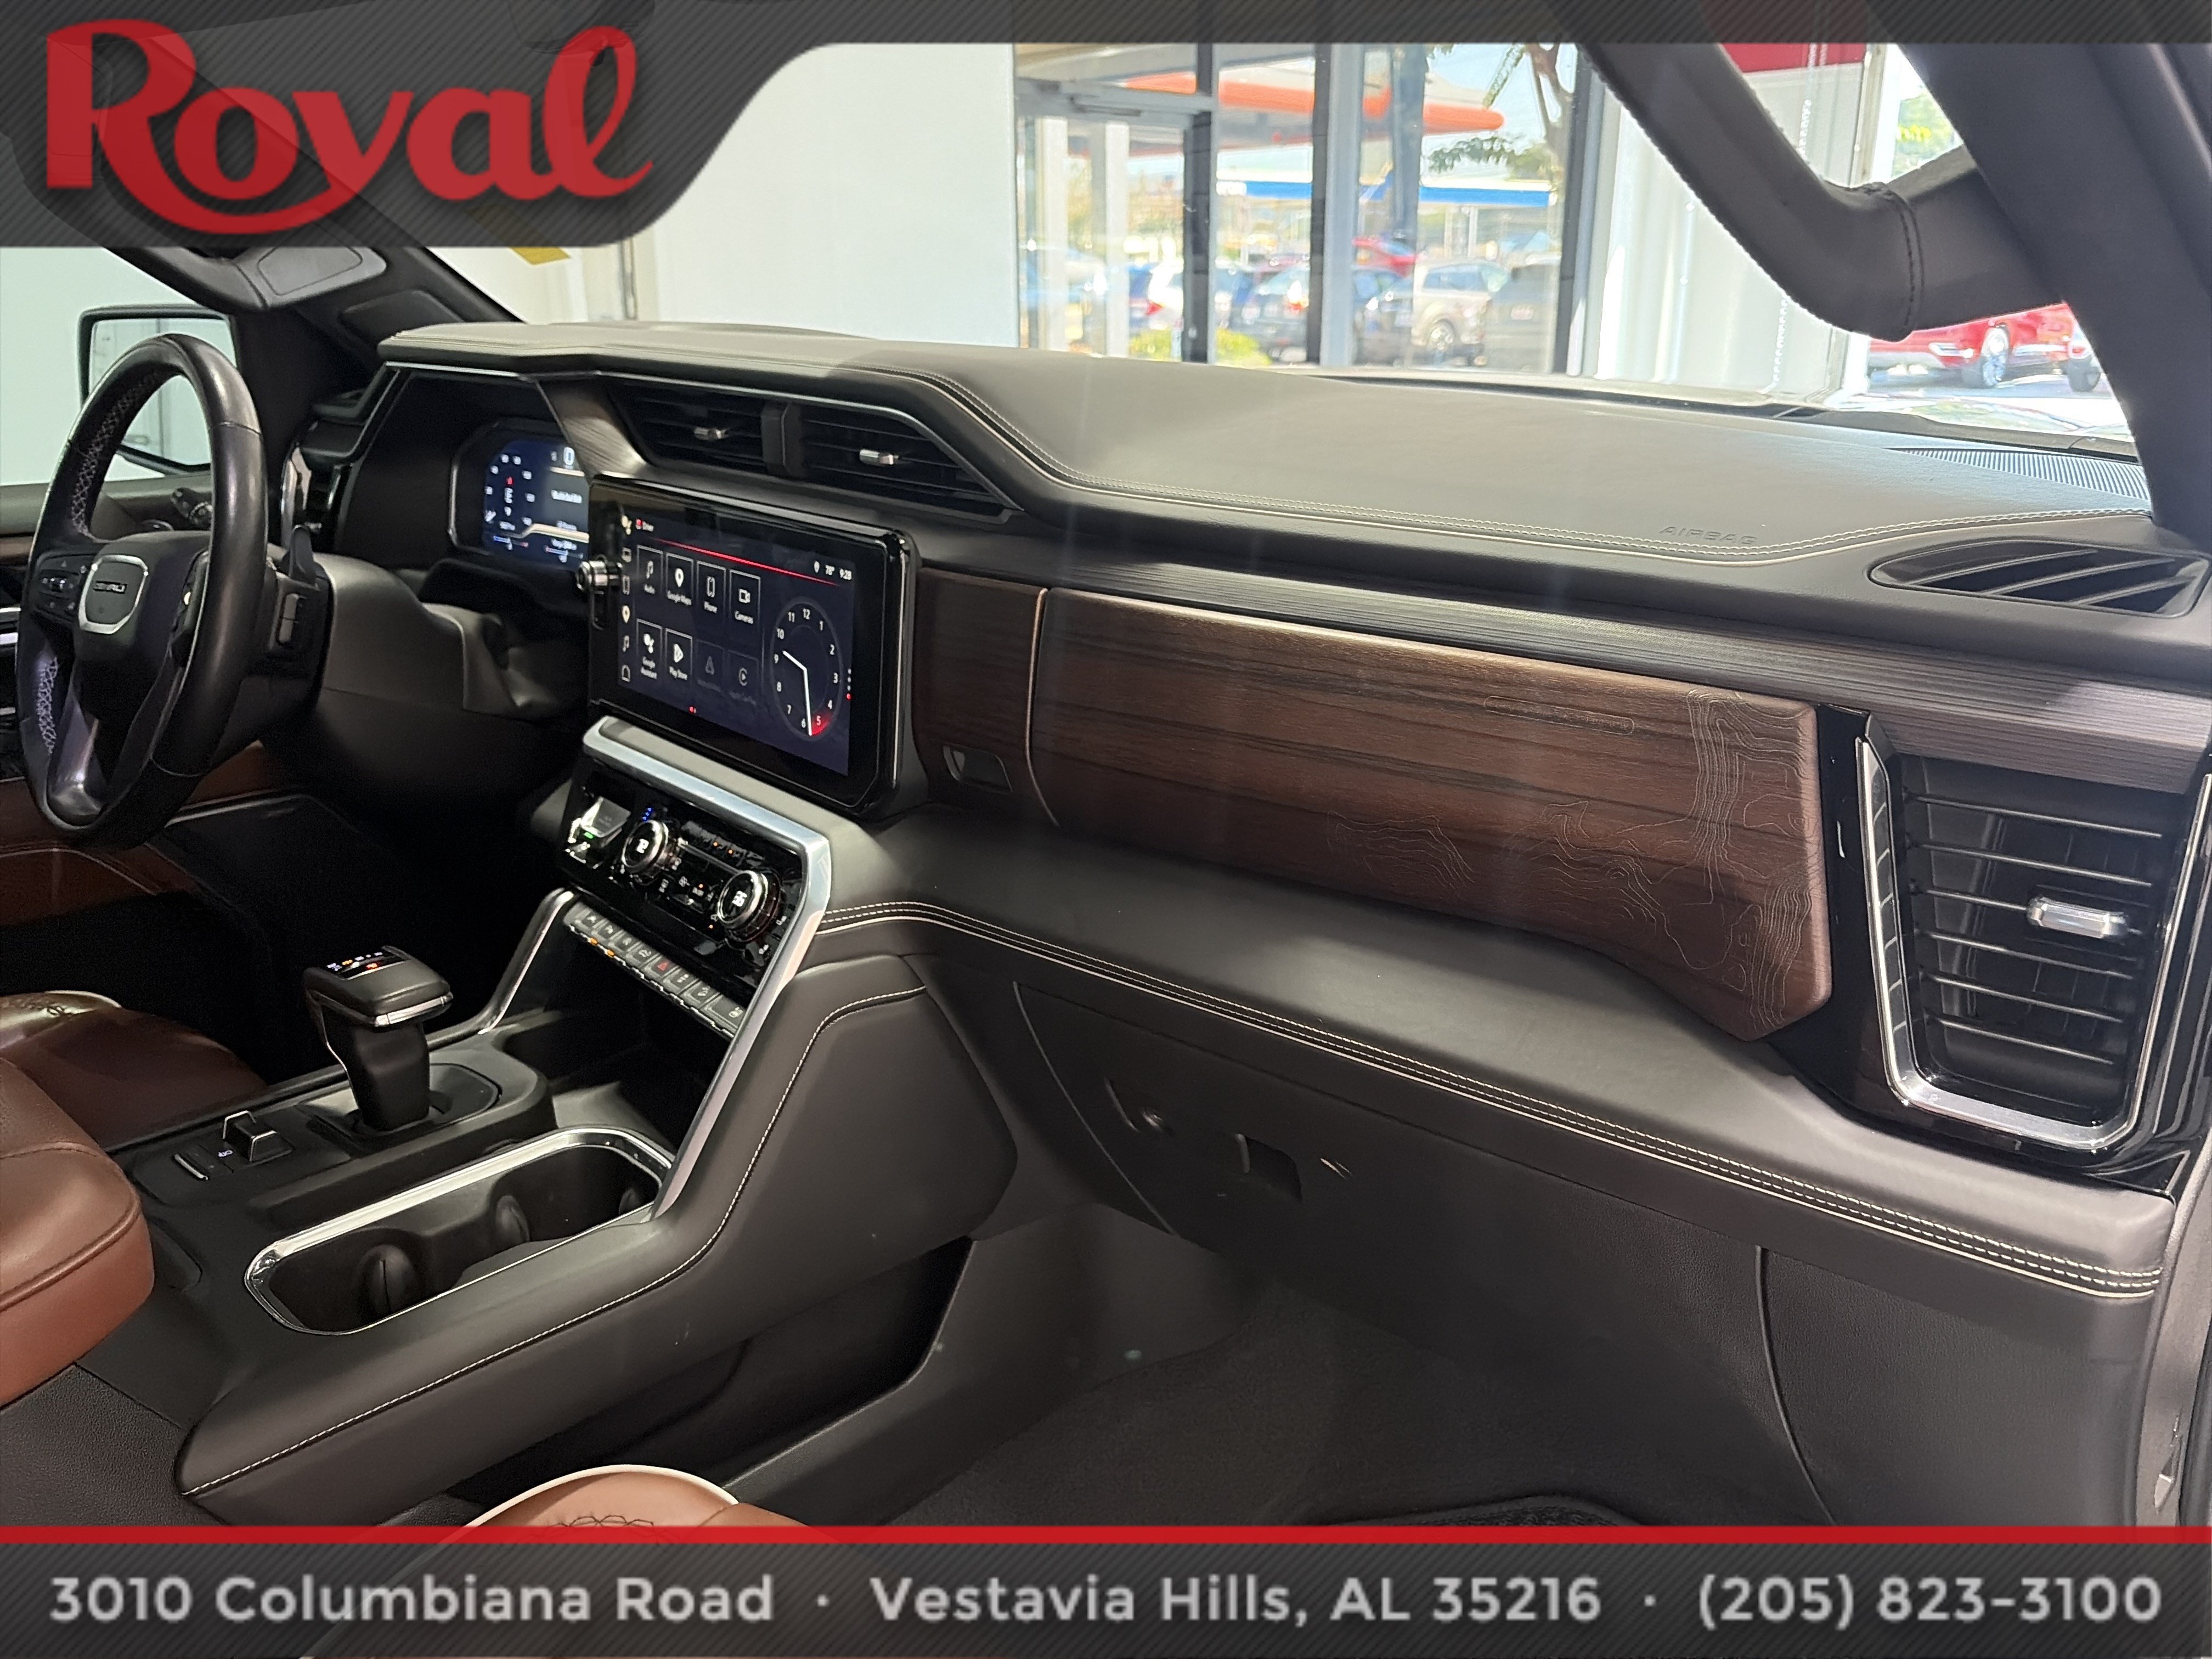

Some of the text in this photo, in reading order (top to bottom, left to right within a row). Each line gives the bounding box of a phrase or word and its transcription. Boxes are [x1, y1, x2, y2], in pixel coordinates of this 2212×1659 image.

[1659, 526, 1757, 545] AIRBAG
[788, 611, 795, 623] 11
[803, 608, 811, 620] 12
[819, 620, 823, 631] 1
[777, 628, 785, 640] 10
[830, 644, 835, 655] 2
[774, 653, 779, 664] 9
[833, 672, 838, 684] 3
[777, 681, 782, 692] 8
[787, 704, 792, 715] 7
[827, 699, 833, 710] 4
[801, 718, 806, 728] 6
[816, 715, 821, 726] 5
